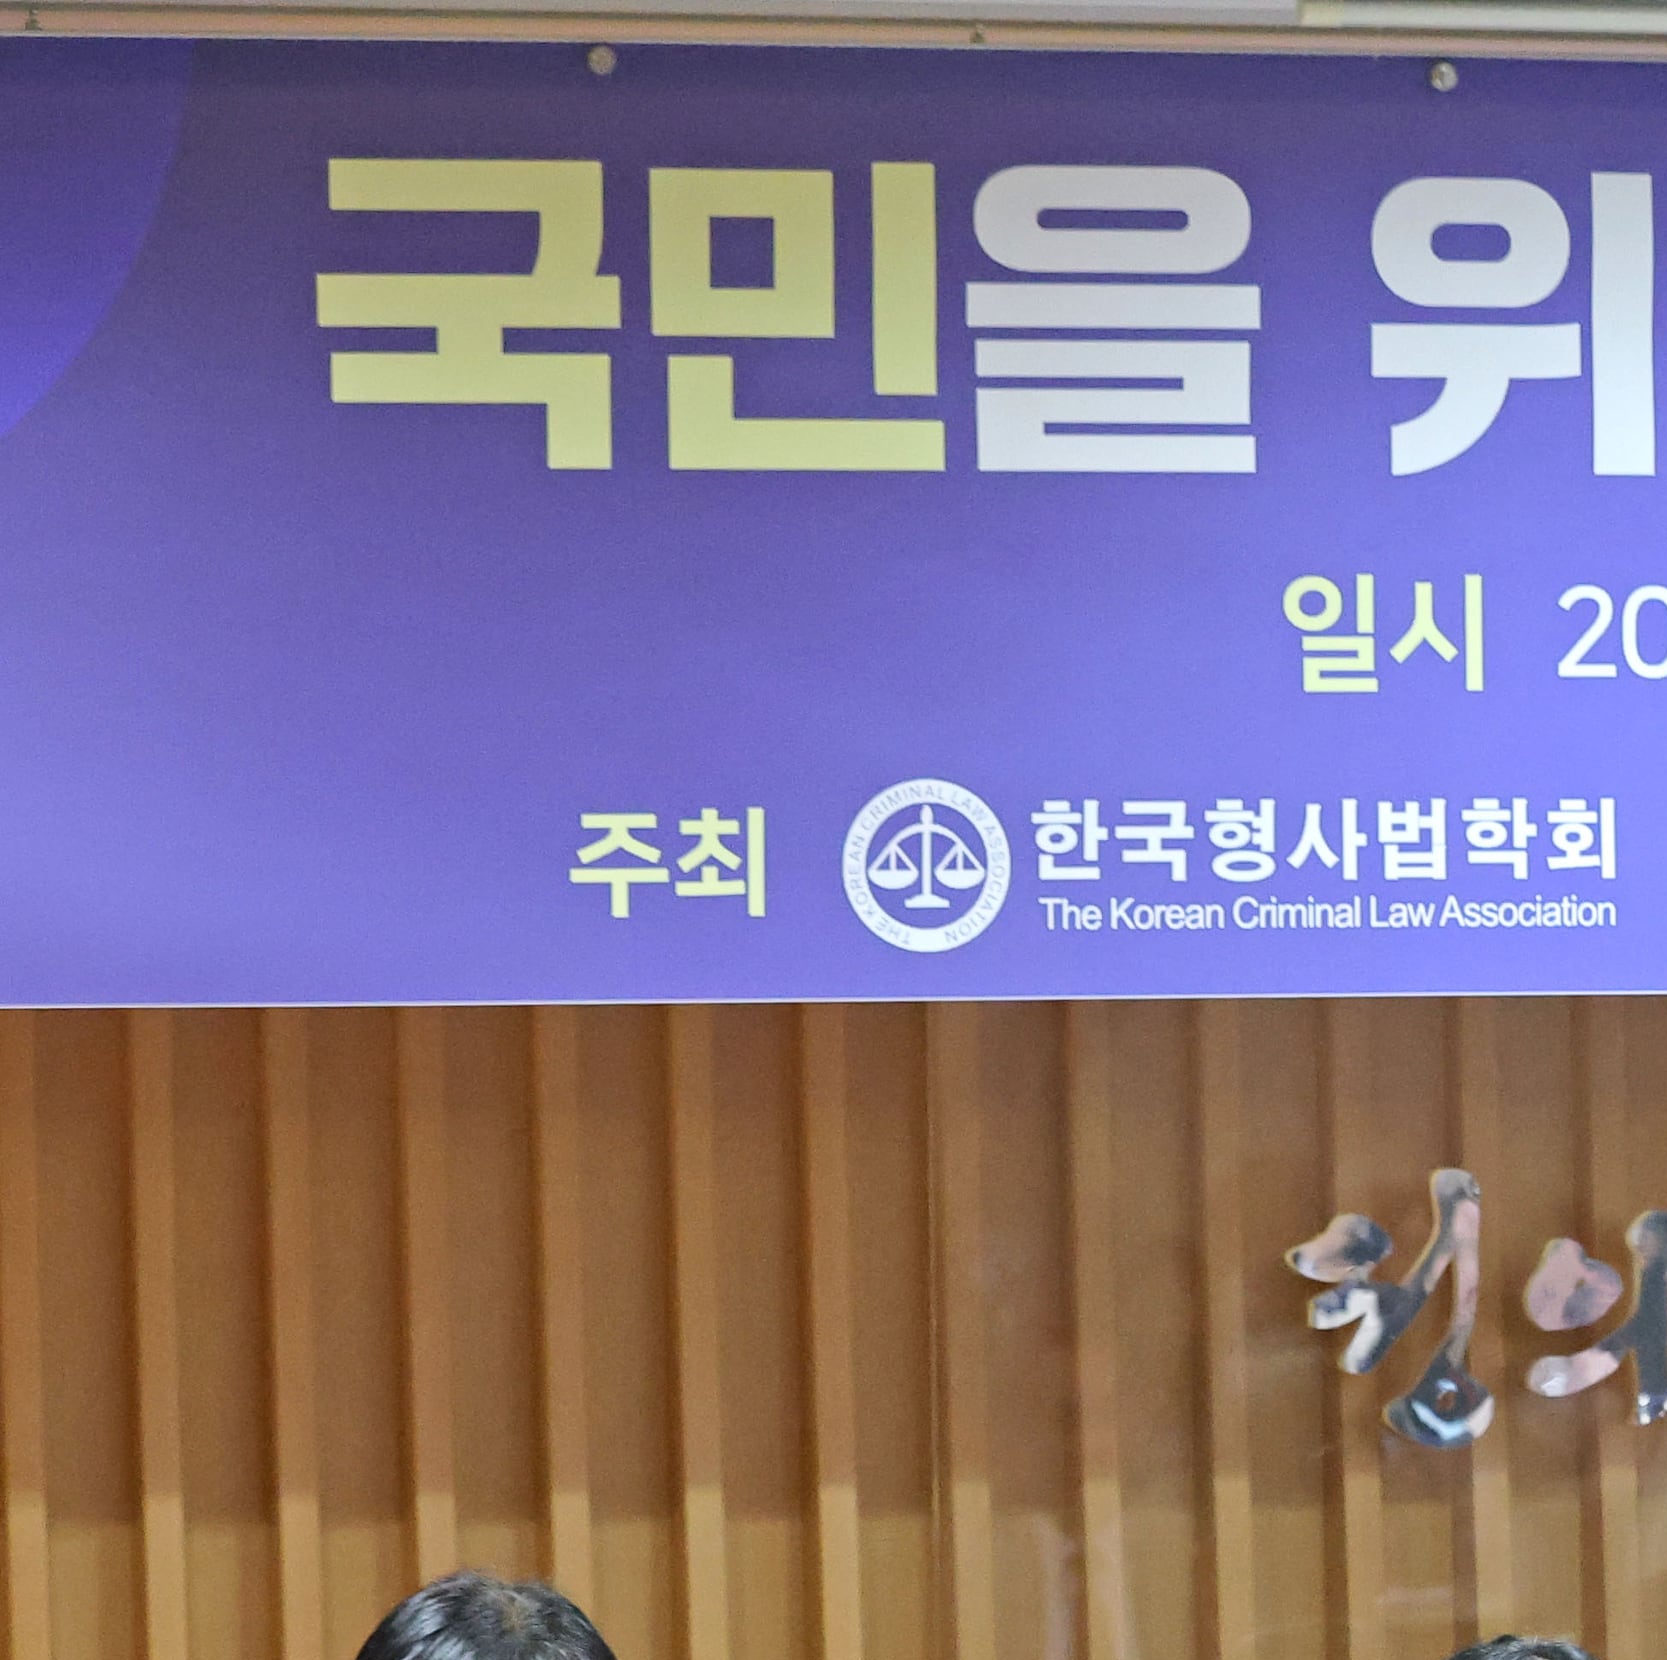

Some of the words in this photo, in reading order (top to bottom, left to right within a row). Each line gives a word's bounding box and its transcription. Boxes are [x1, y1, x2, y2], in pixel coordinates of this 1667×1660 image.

[317, 159, 1260, 473] 국민을
[1284, 574, 1483, 692] 일시
[570, 807, 765, 917] 주최
[1032, 798, 1615, 881] 한국형사법학회
[1039, 898, 1102, 930] The
[1111, 898, 1224, 929] Korean
[1233, 896, 1360, 929] Criminal
[1370, 896, 1435, 927] Law
[1441, 895, 1616, 927] Association
